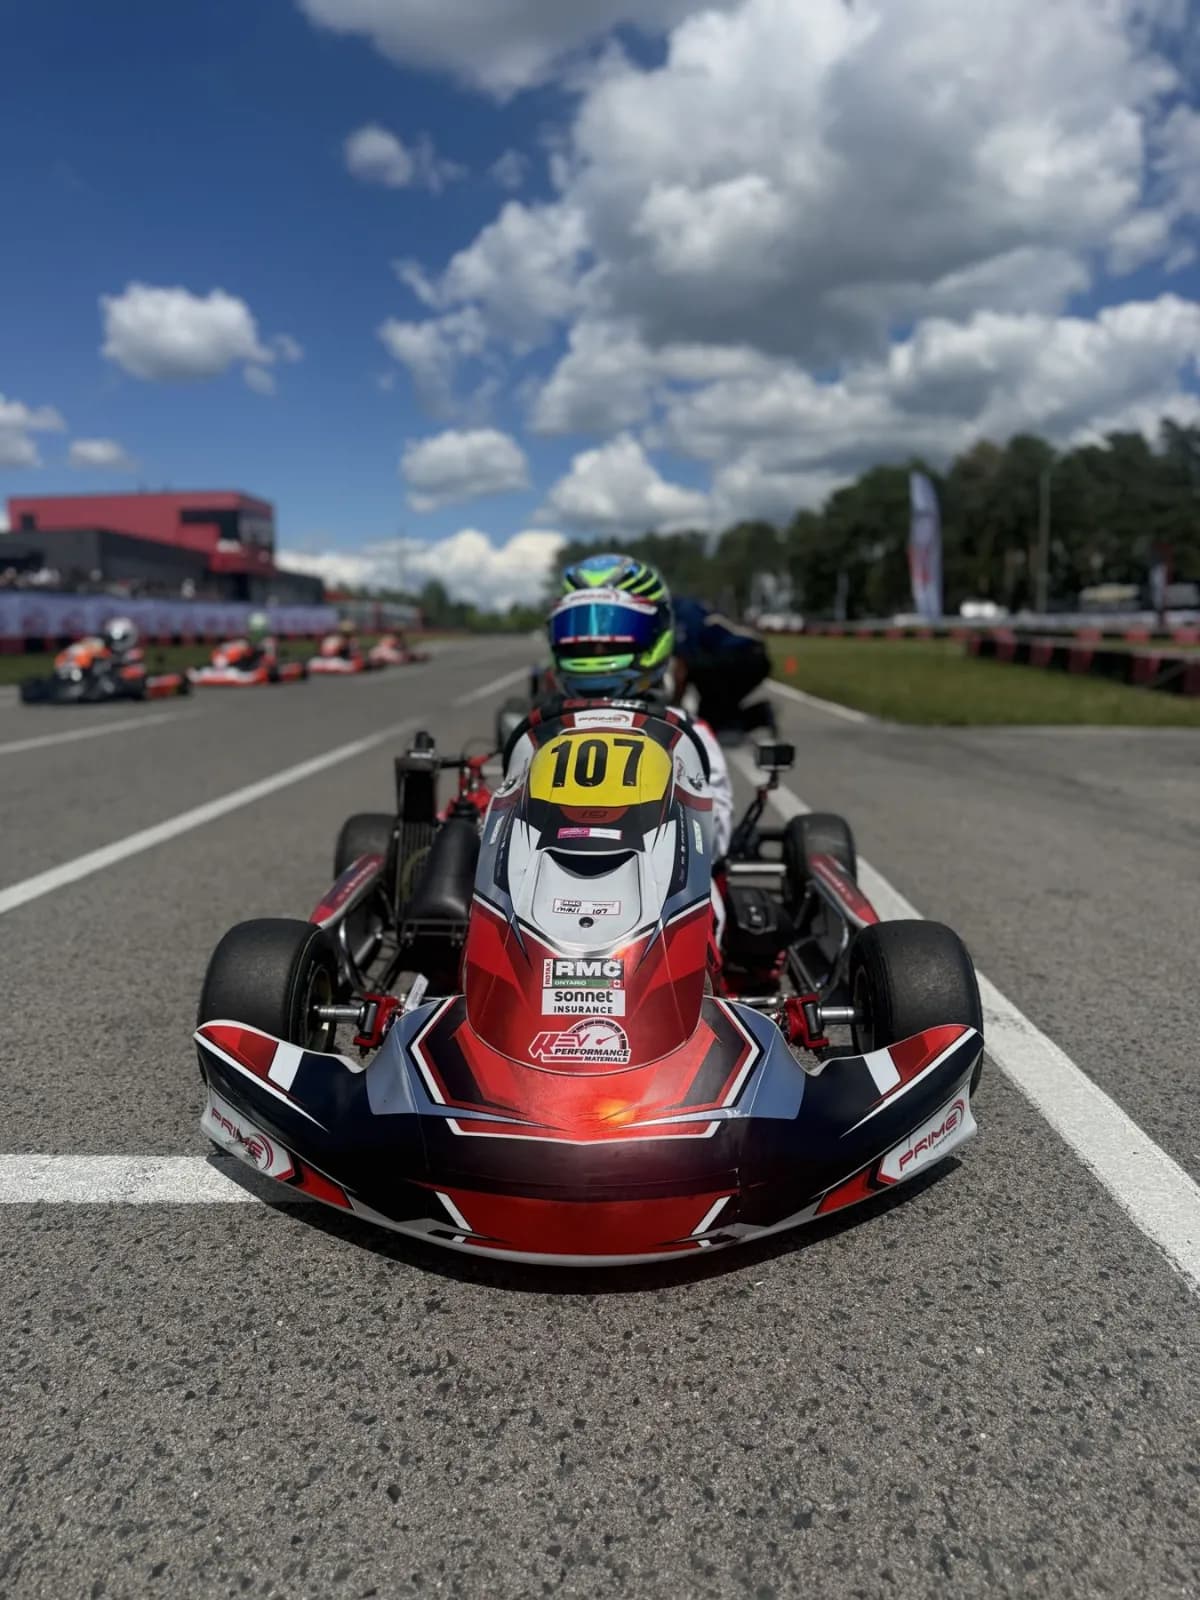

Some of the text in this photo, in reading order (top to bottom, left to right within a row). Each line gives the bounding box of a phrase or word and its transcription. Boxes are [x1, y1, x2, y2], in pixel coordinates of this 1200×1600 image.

[551, 738, 644, 788] 107
[556, 961, 621, 977] RMC
[554, 991, 613, 1003] sonnet
[553, 1006, 613, 1014] INSURANCE
[554, 1048, 630, 1057] PERFORMANCE
[899, 1111, 958, 1172] PRIME
